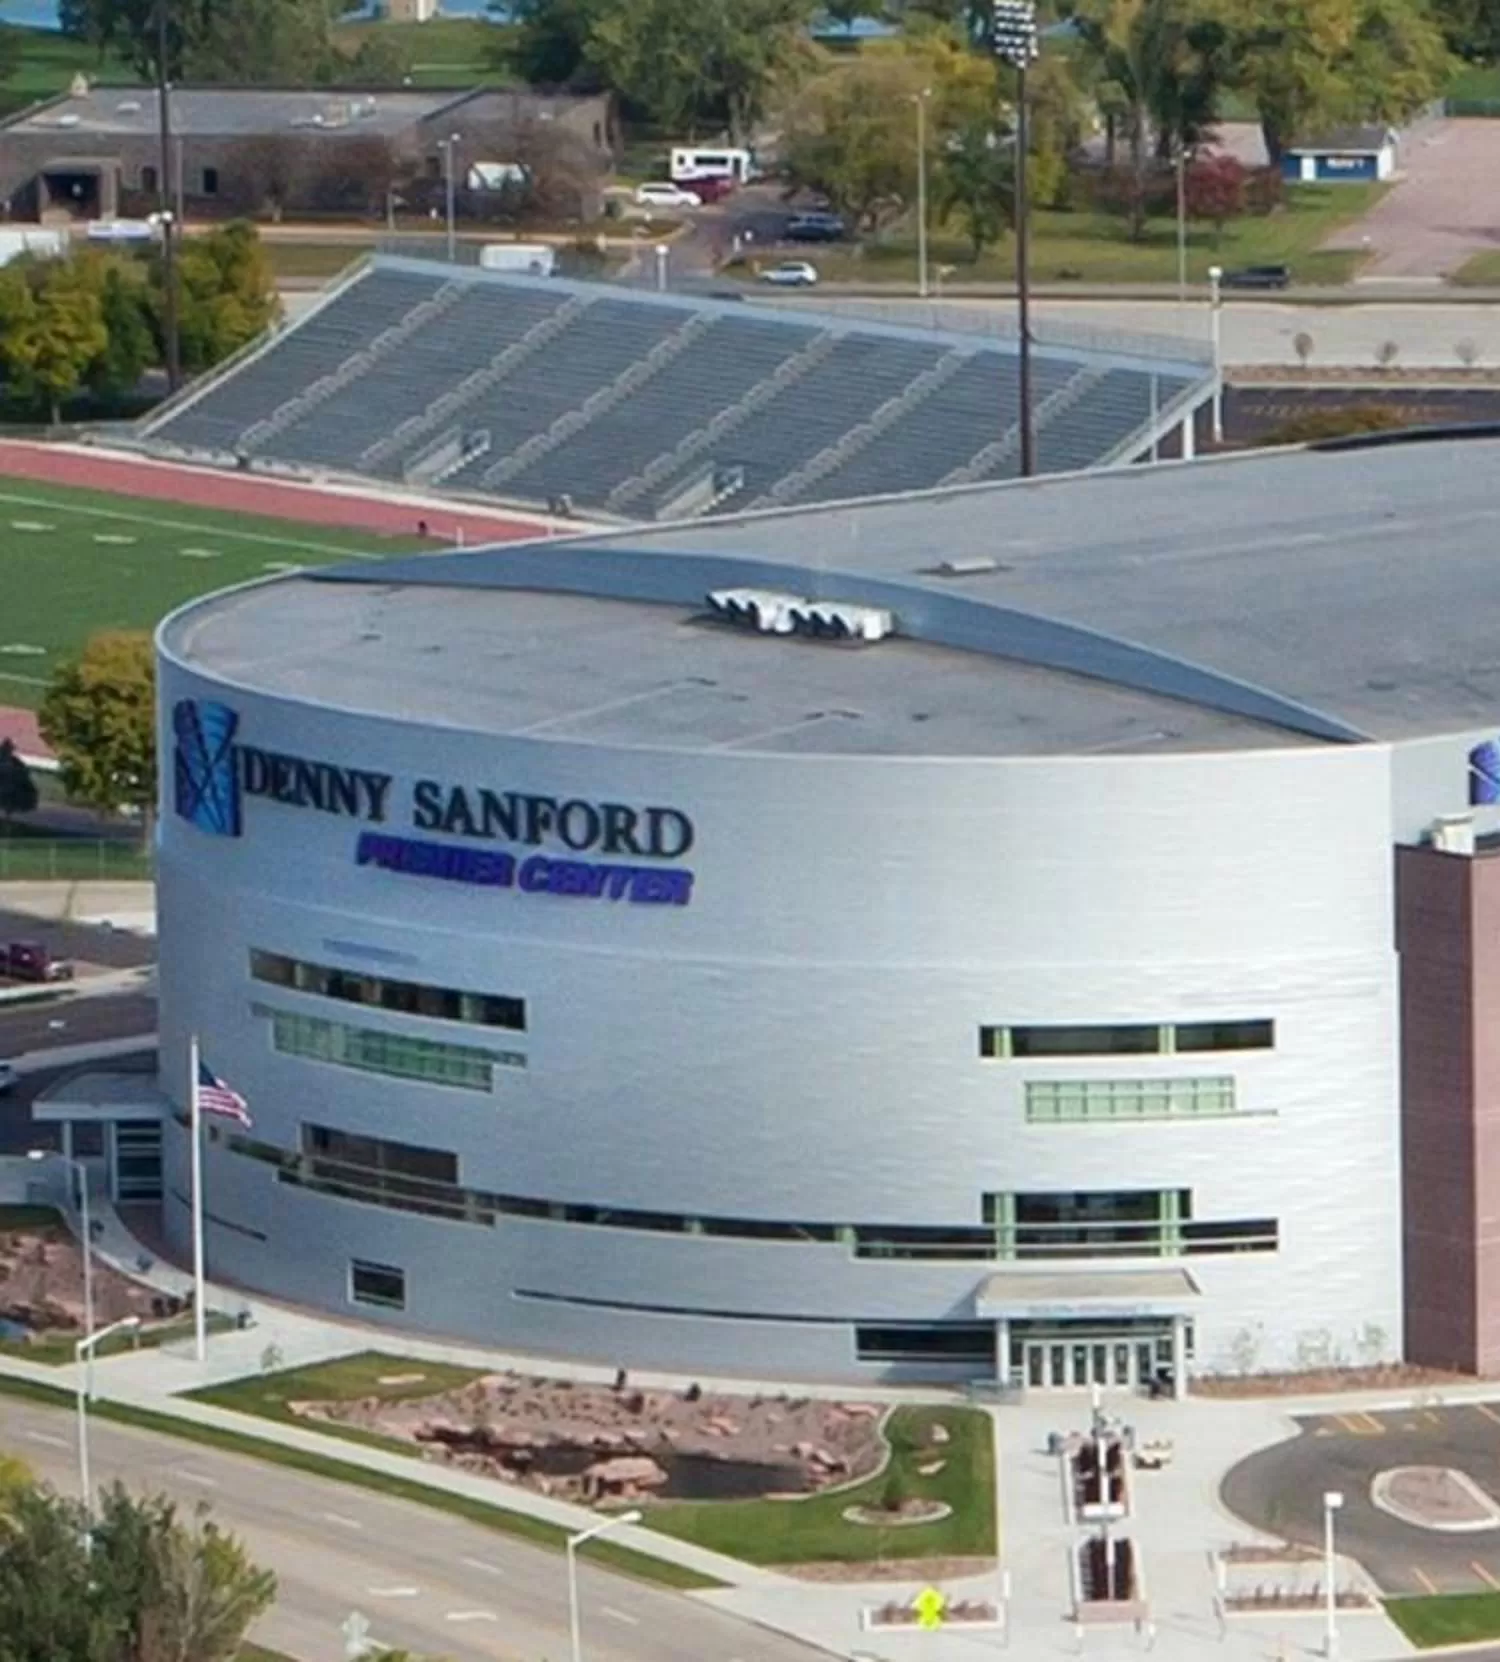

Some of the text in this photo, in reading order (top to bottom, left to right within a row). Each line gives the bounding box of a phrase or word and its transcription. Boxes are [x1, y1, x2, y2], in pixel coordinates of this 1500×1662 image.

[243, 744, 694, 858] DENNY SANFORD
[356, 831, 694, 905] PREMIER CENTER
